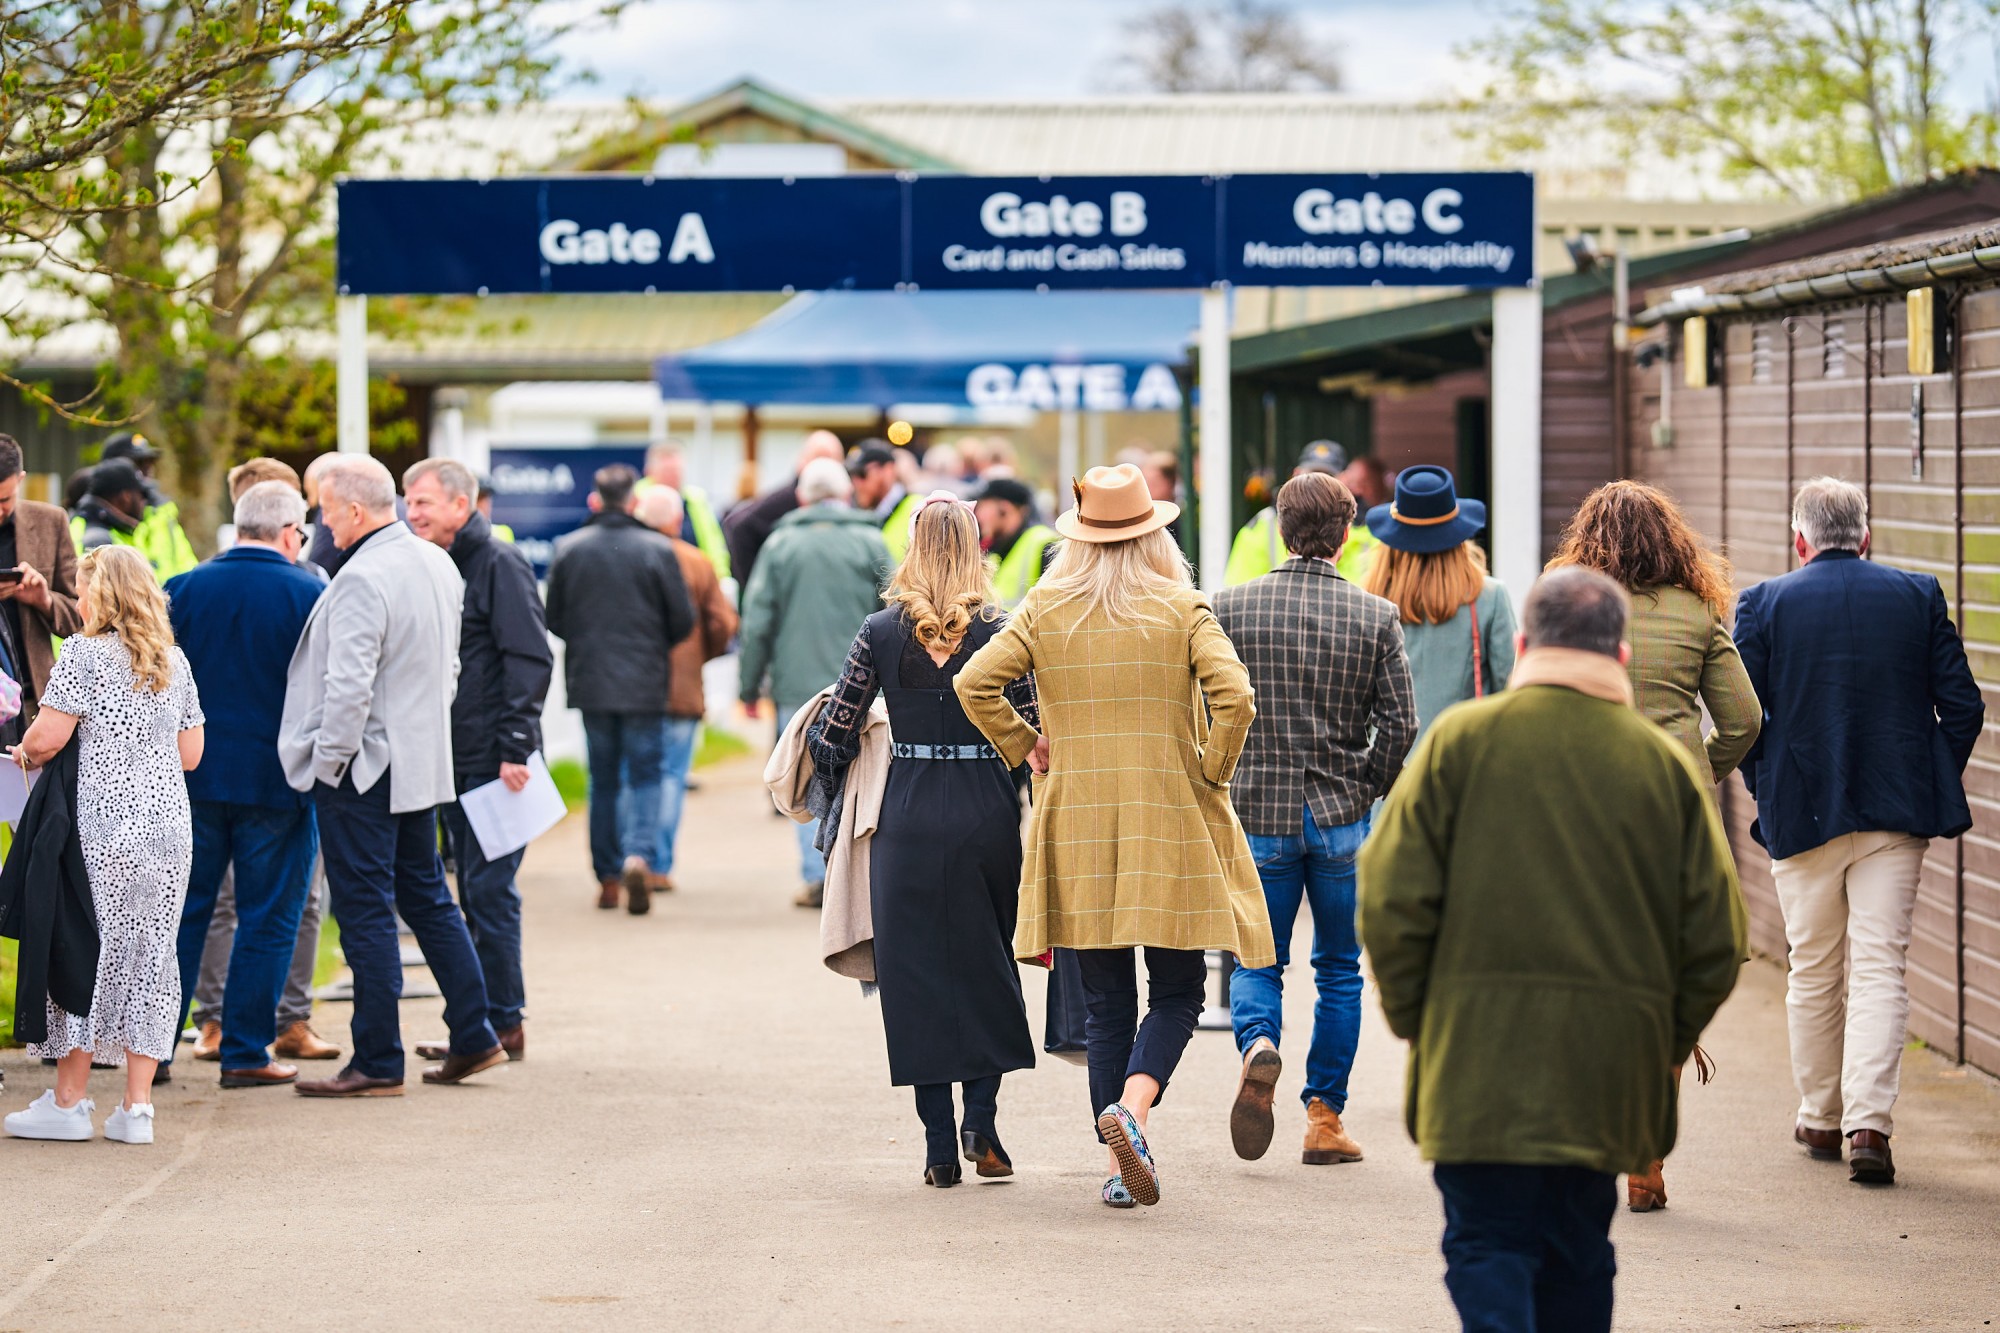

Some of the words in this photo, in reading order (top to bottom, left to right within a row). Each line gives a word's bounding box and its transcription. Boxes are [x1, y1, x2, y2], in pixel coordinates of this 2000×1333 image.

[981, 192, 1104, 238] Gate
[1110, 191, 1148, 237] B
[1293, 188, 1417, 235] Gate
[1422, 188, 1465, 235] C
[541, 219, 662, 265] Gate
[669, 212, 716, 264] A
[943, 245, 1005, 272] Card
[1006, 245, 1055, 272] and
[1056, 244, 1120, 271] Cash
[1121, 243, 1187, 271] Sales
[1243, 241, 1359, 269] Members
[1359, 241, 1381, 269] &
[1383, 241, 1515, 273] Hospitality
[966, 364, 1128, 411] GATE
[1132, 364, 1182, 410] A
